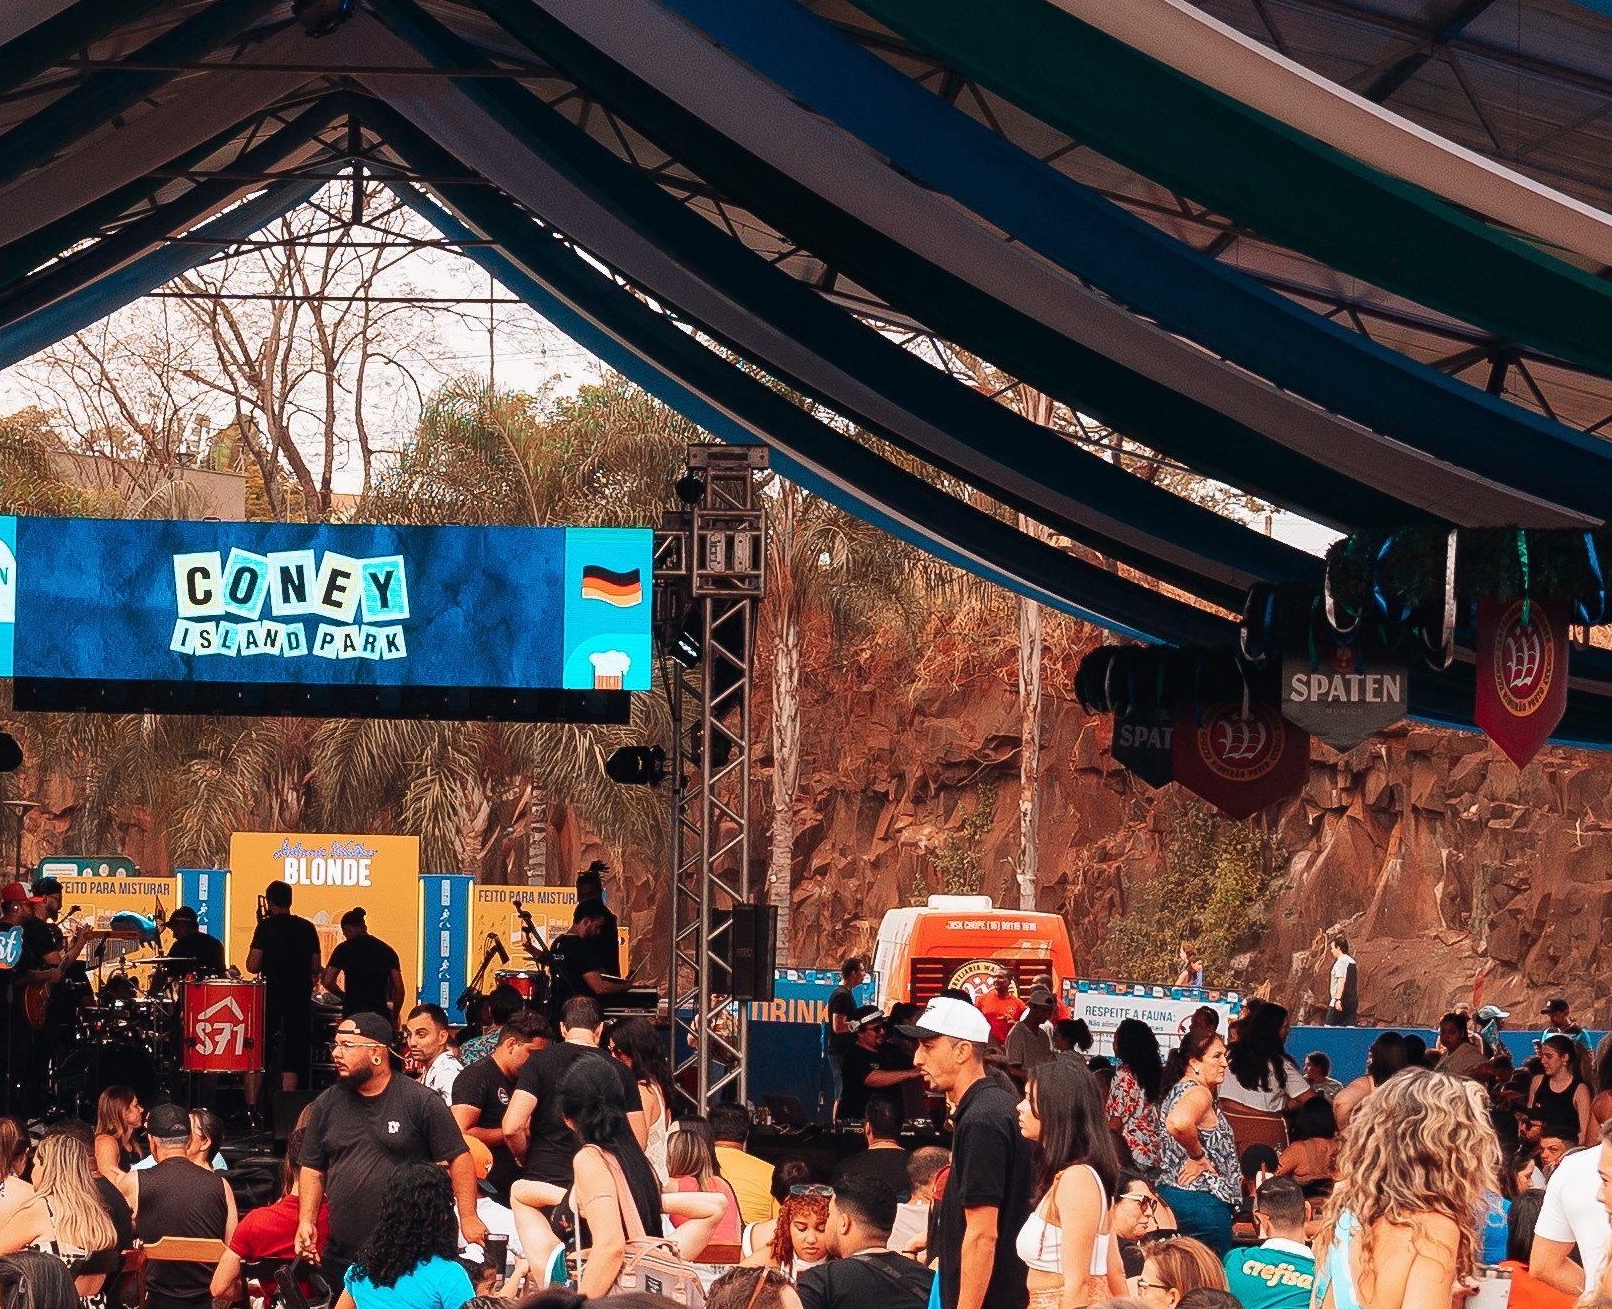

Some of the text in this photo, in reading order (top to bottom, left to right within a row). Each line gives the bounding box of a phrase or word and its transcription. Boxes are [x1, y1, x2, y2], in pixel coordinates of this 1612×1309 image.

[186, 564, 395, 609] CONEY
[180, 627, 401, 654] ISLAND PARK
[1289, 673, 1402, 703] SPATEN
[283, 856, 373, 887] BLONDE
[89, 881, 117, 896] PARA
[118, 882, 171, 896] MISTURAR
[478, 889, 507, 904] FEITO
[508, 890, 535, 905] PARA
[1085, 1005, 1130, 1019] RESPEITE
[1141, 1009, 1177, 1023] FAUNA:
[195, 1021, 246, 1056] S71
[1242, 1259, 1314, 1290] crefisa
